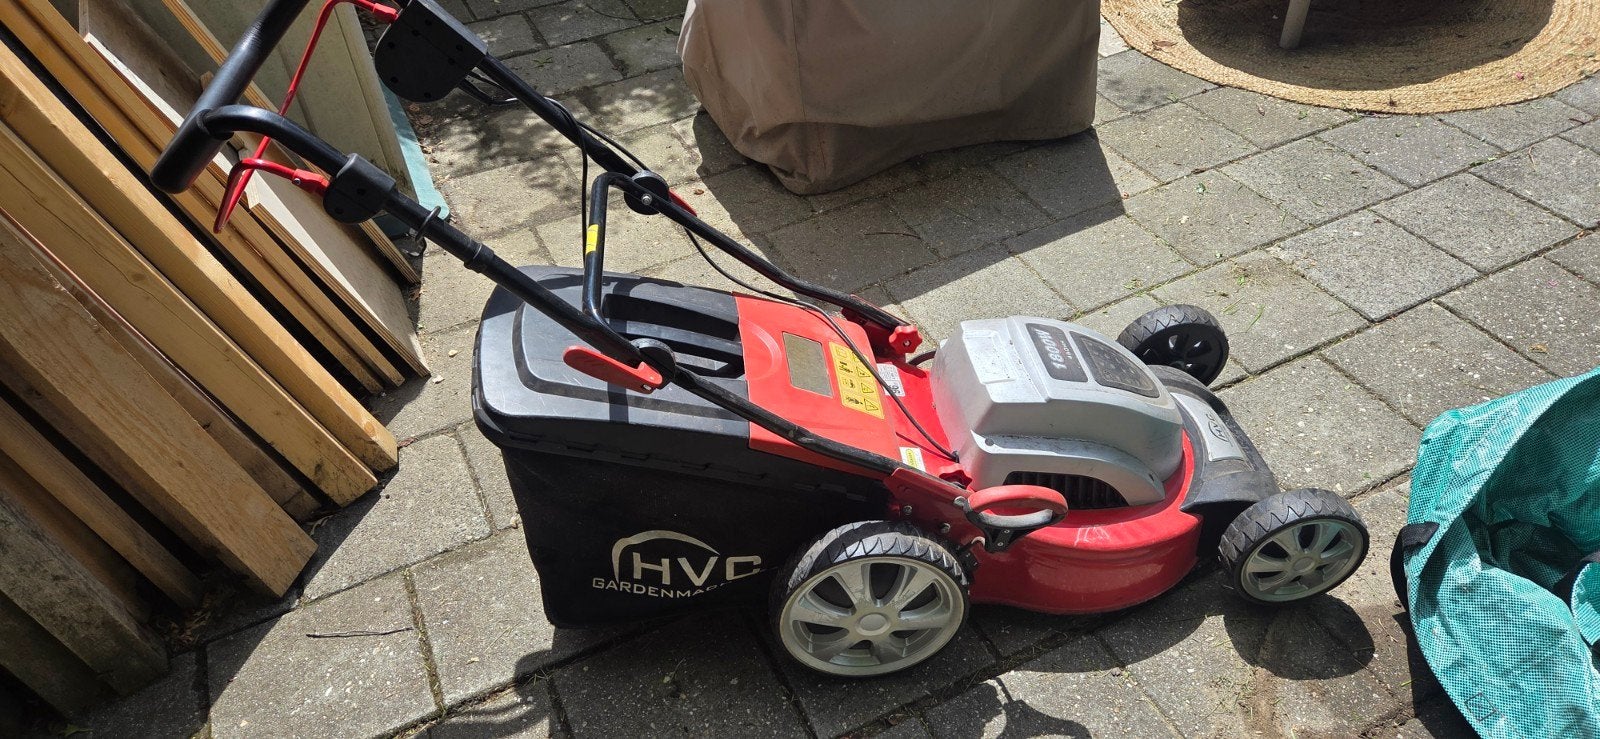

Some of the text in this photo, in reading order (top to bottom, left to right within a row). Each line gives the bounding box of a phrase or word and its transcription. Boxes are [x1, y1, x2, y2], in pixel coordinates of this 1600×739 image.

[1033, 327, 1067, 369] 1800W
[632, 552, 762, 586] HVC
[592, 577, 732, 598] GARDENMA
